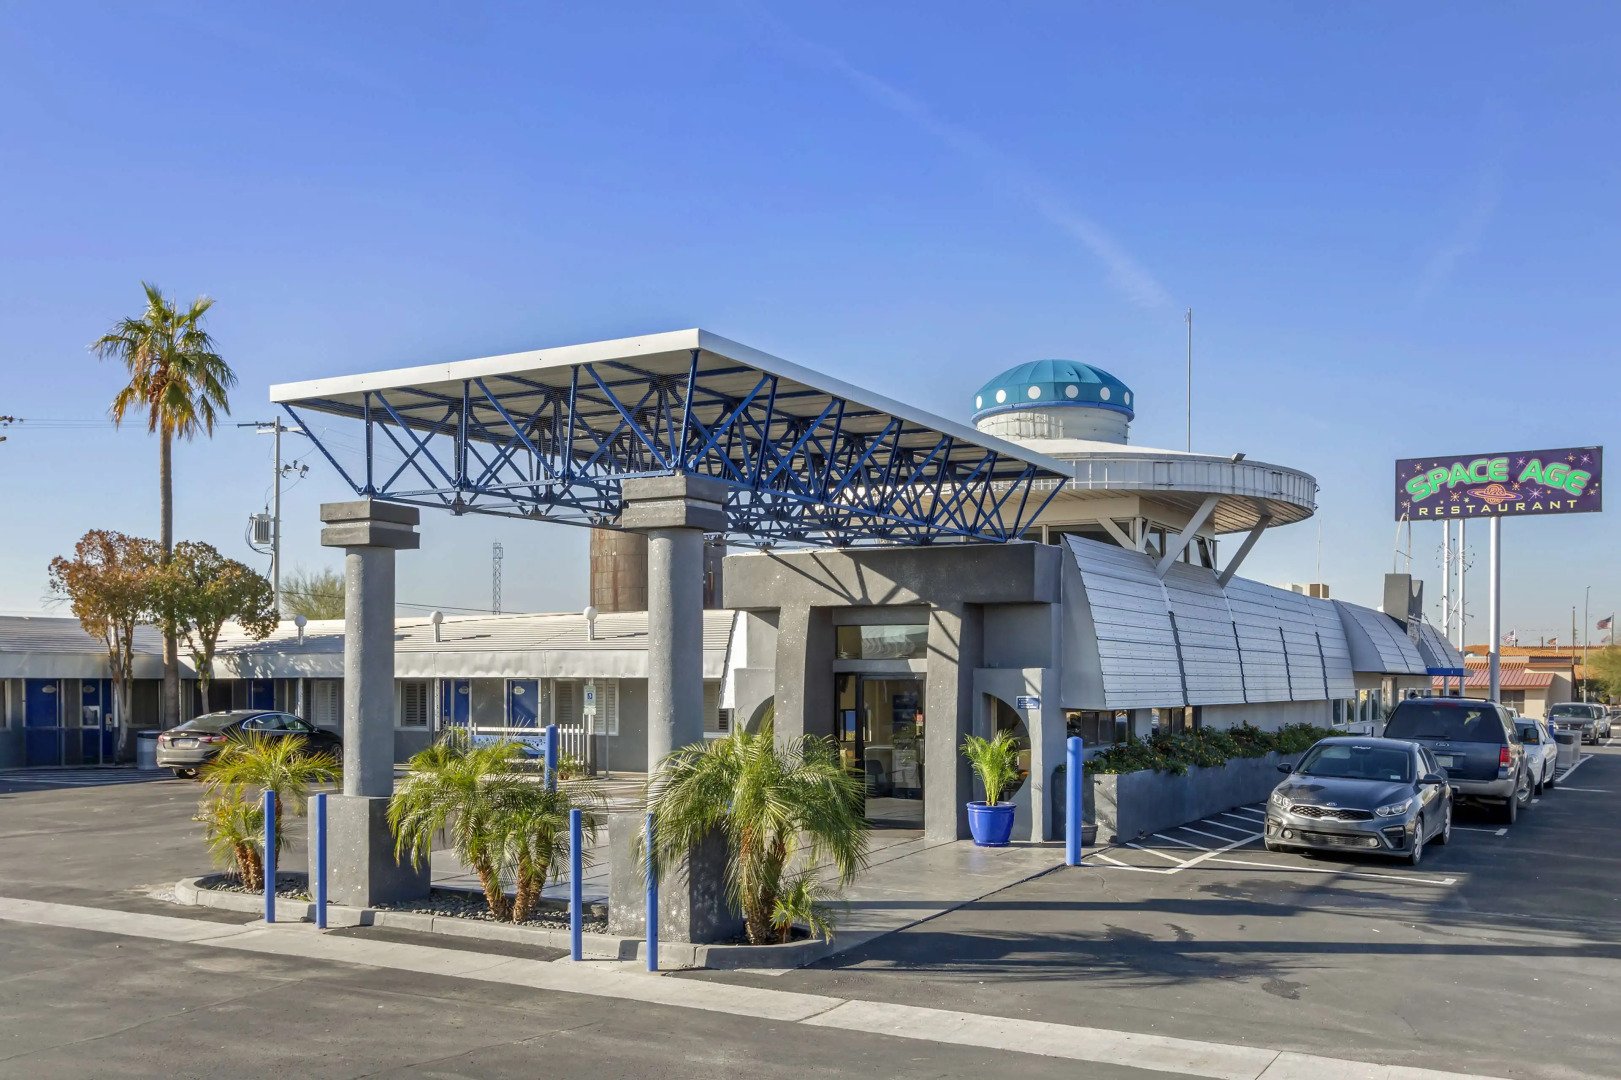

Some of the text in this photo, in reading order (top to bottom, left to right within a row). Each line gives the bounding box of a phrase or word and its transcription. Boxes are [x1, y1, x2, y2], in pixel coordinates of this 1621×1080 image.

[1405, 458, 1591, 502] SPACE AGE
[1418, 500, 1578, 516] RESTAURANT
